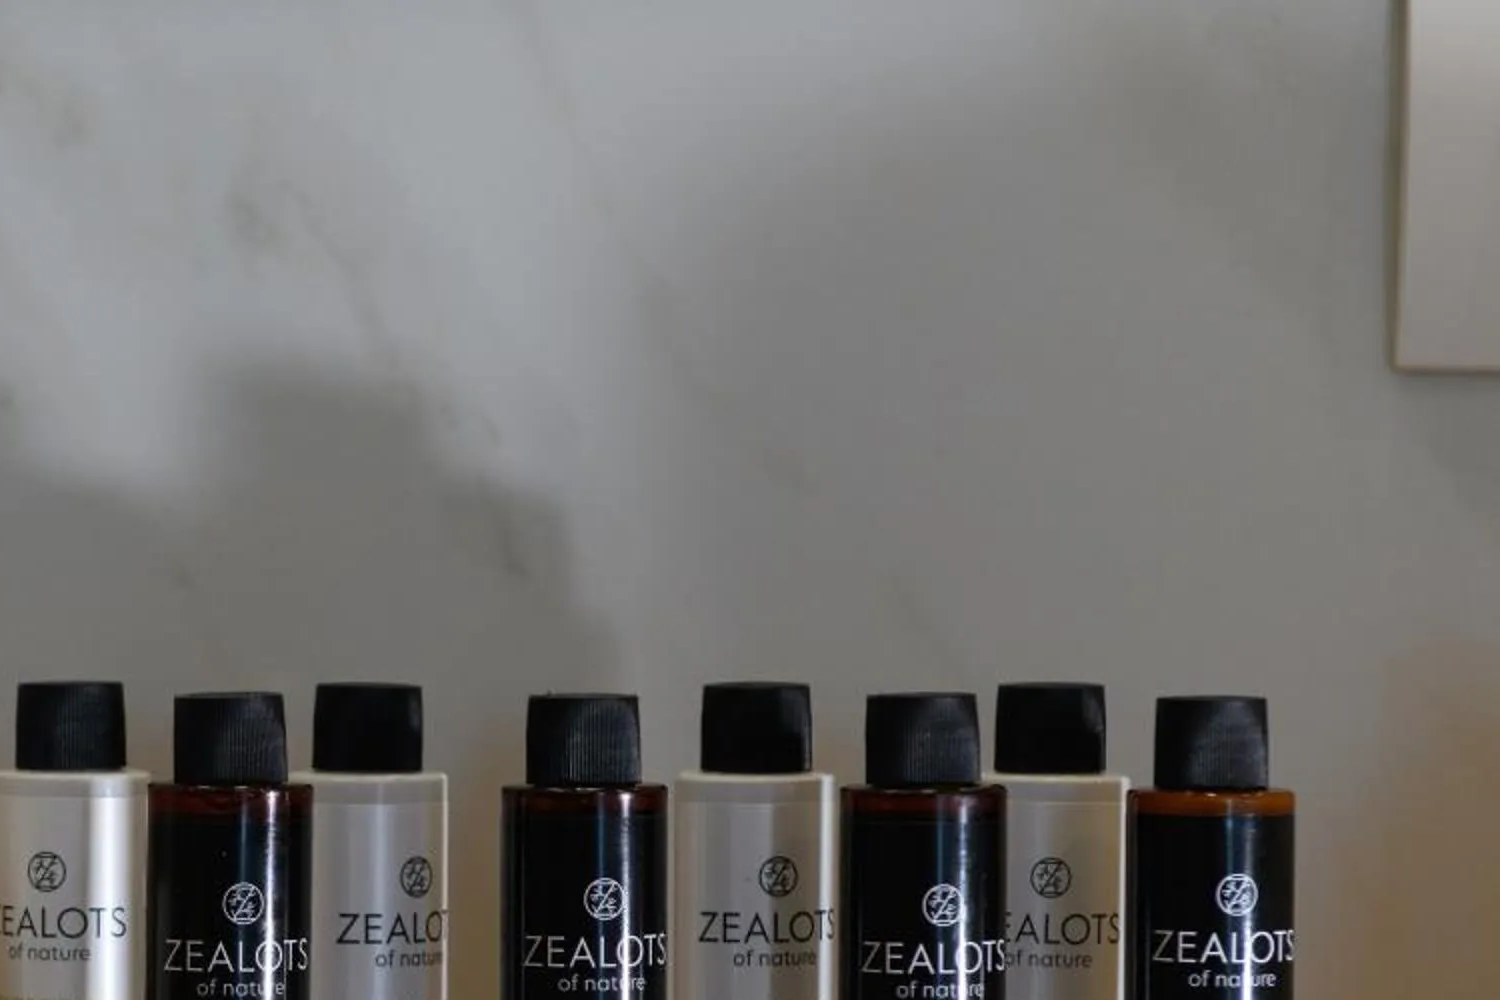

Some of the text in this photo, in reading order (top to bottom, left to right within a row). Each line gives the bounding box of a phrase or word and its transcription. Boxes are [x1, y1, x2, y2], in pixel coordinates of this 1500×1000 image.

[336, 909, 448, 945] ZEALO
[698, 908, 834, 943] ZEALOTS
[1004, 911, 1121, 946] EALOTS
[8, 944, 92, 961] of nature
[164, 937, 308, 973] ZEALOTS
[523, 933, 667, 968] ZEALOTS
[1152, 929, 1294, 964] ZEALOTS
[375, 950, 394, 967] of
[733, 949, 817, 967] of nature
[861, 939, 1005, 975] ZEALOTS
[1028, 951, 1092, 968] nature
[196, 978, 285, 997] of natue
[557, 973, 646, 992] of natre
[1188, 969, 1276, 987] of naure
[896, 980, 984, 999] of natre
